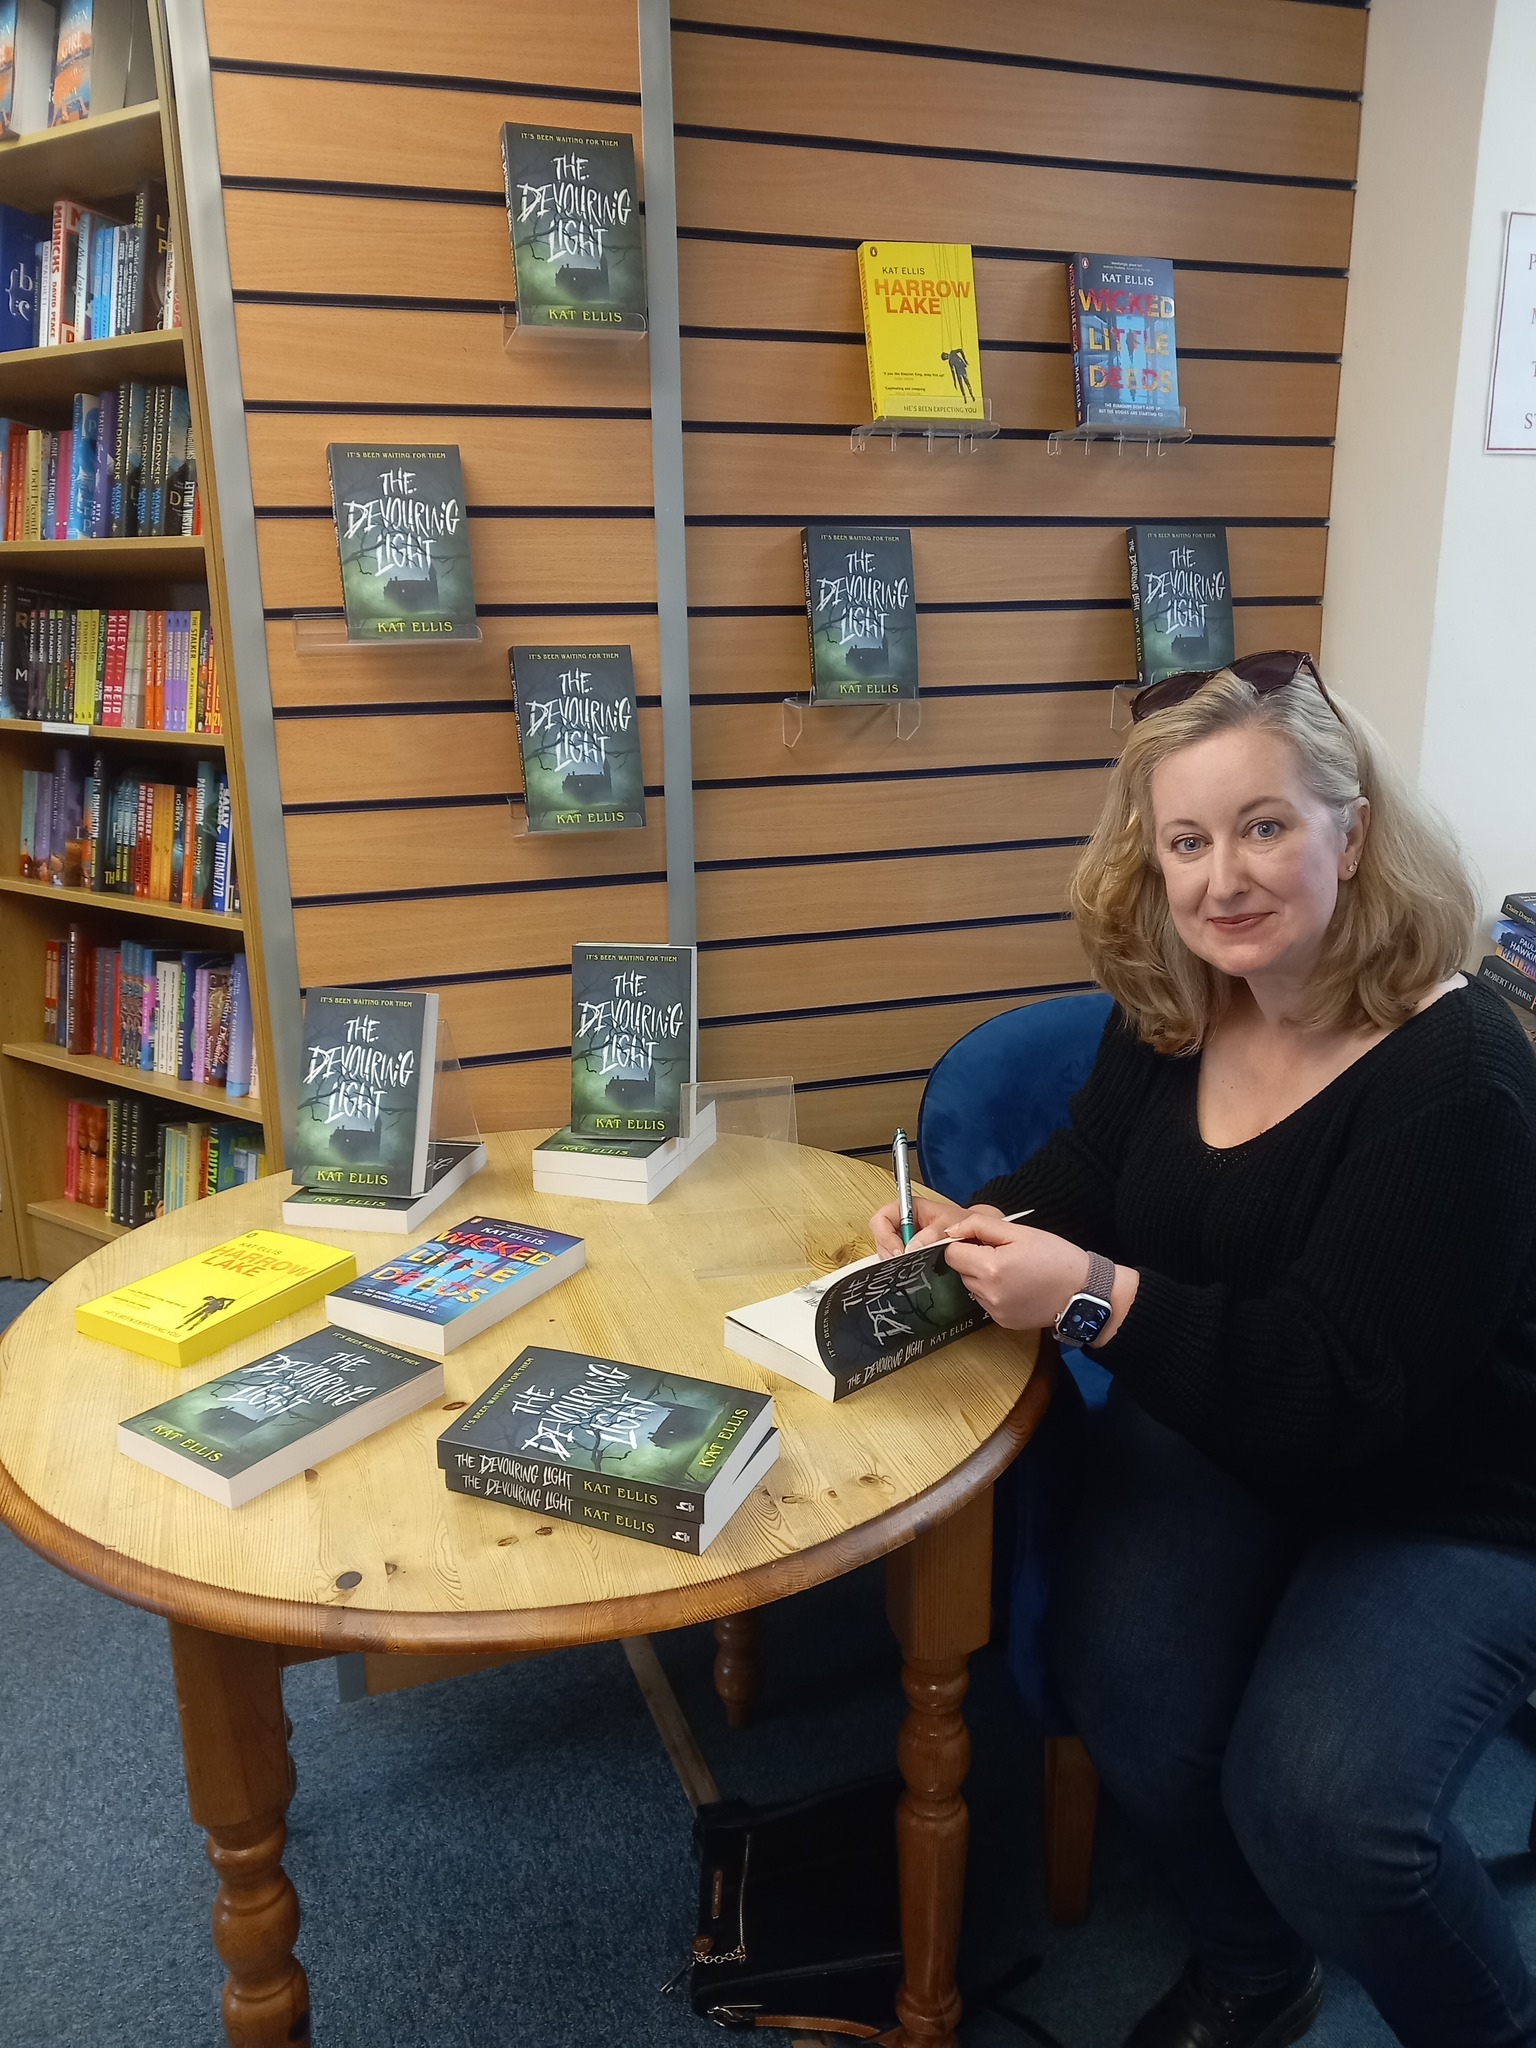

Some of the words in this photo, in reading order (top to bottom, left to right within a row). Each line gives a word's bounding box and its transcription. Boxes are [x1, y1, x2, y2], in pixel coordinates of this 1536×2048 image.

[521, 132, 535, 140] IT'S
[536, 133, 554, 142] BEEN
[555, 135, 584, 144] WAITING
[585, 138, 599, 146] FOR
[601, 139, 619, 147] THEM
[551, 152, 590, 181] THE
[517, 182, 632, 226] DEVOURING
[52, 206, 62, 274] MUNICHS
[547, 220, 609, 263] LIGHT
[902, 267, 925, 275] ELLIS
[1101, 272, 1122, 283] KAT
[1125, 275, 1155, 286] ELLIS
[874, 279, 971, 298] HARROW
[1078, 288, 1175, 319] WICKED
[549, 309, 577, 320] KAT
[583, 311, 623, 322] ELLIS
[885, 297, 941, 314] LAKE
[1089, 327, 1169, 356] LITTLE
[1089, 365, 1173, 394] DEEDS
[47, 479, 55, 515] PENGUINS
[183, 481, 195, 508] PULLEY
[377, 467, 417, 497] THE
[182, 509, 193, 536] ATASHA
[343, 497, 460, 539] DEVOURING
[375, 533, 437, 577] LIGHT
[845, 549, 876, 573] THE
[1169, 545, 1196, 568] THE
[815, 575, 909, 611] DEVOURING
[1144, 570, 1226, 604] DEVOURING
[377, 622, 406, 633] KAT
[412, 621, 453, 632] ELLIS
[839, 607, 889, 645] LIGHT
[1166, 599, 1209, 635] LIGHT
[107, 615, 116, 651] KILEY
[116, 615, 127, 651] KILEY
[190, 628, 198, 659] STALKER
[556, 667, 593, 697] THE
[839, 684, 862, 694] KAT
[867, 684, 899, 694] ELLIS
[103, 686, 112, 713] REID
[113, 686, 122, 713] REID
[525, 697, 632, 737] DEVOURING
[554, 730, 611, 773] LIGHT
[556, 813, 582, 824] KAT
[588, 812, 624, 823] ELLIS
[213, 841, 227, 897] INTERMEZZO
[610, 970, 647, 998] THE
[1483, 968, 1509, 988] ROBERT
[1508, 983, 1533, 1002] HARRIS
[334, 997, 351, 1005] BEEN
[353, 998, 379, 1006] WAITING
[344, 1014, 381, 1045] THE
[574, 998, 684, 1040] DEVOURING
[303, 1043, 415, 1088] DEVOURING
[598, 1033, 659, 1075] LIGHT
[324, 1081, 388, 1124] LIGHT
[595, 1118, 622, 1129] KAT
[627, 1120, 666, 1131] ELLIS
[316, 1169, 344, 1181] KAT
[349, 1172, 389, 1185] ELLIS
[312, 1196, 343, 1204] KAT
[347, 1198, 387, 1207] ELLIS
[238, 1242, 258, 1251] KAT
[257, 1245, 283, 1256] ELLIS
[434, 1230, 557, 1267] WICKED
[480, 1226, 506, 1237] KAT
[507, 1232, 547, 1246] ELLIS
[200, 1256, 268, 1277] LAKE
[210, 1246, 317, 1277] HARROW
[406, 1248, 520, 1284] LITTLE
[370, 1267, 489, 1304] DEEDS
[841, 1274, 870, 1314] THE
[321, 1351, 372, 1373] THE
[345, 1337, 363, 1345] BEEN
[362, 1343, 388, 1355] WAITING
[387, 1352, 402, 1360] FOR
[401, 1357, 420, 1366] THEM
[825, 1340, 836, 1358] IT'S
[847, 1372, 862, 1390] THE
[862, 1351, 904, 1385] DEVOURING
[904, 1340, 925, 1363] LIGHT
[929, 1331, 948, 1347] KAT
[950, 1318, 975, 1337] ELLIS
[237, 1353, 377, 1407] DEVOURING
[461, 1419, 476, 1431] IT'S
[472, 1405, 490, 1420] BEEN
[487, 1383, 511, 1405] WAITING
[507, 1372, 521, 1382] FOR
[517, 1357, 534, 1371] THEM
[217, 1380, 311, 1417] LIGHT
[510, 1384, 556, 1416] THE
[520, 1362, 633, 1462] DEVOURING
[589, 1389, 658, 1450] LIGHT
[150, 1424, 183, 1441] KAT
[180, 1436, 224, 1463] ELLIS
[698, 1442, 725, 1468] KAT
[722, 1407, 750, 1441] ELLIS
[454, 1453, 476, 1468] THE
[478, 1457, 540, 1485] DEVOURING
[543, 1466, 573, 1490] LIGHT
[582, 1479, 611, 1495] KAT
[616, 1489, 659, 1506] ELLIS
[462, 1474, 482, 1490] THE
[485, 1478, 542, 1508] DEVOURING
[545, 1491, 574, 1516] LIGHT
[583, 1506, 610, 1522] KAT
[615, 1515, 656, 1534] ELLIS
